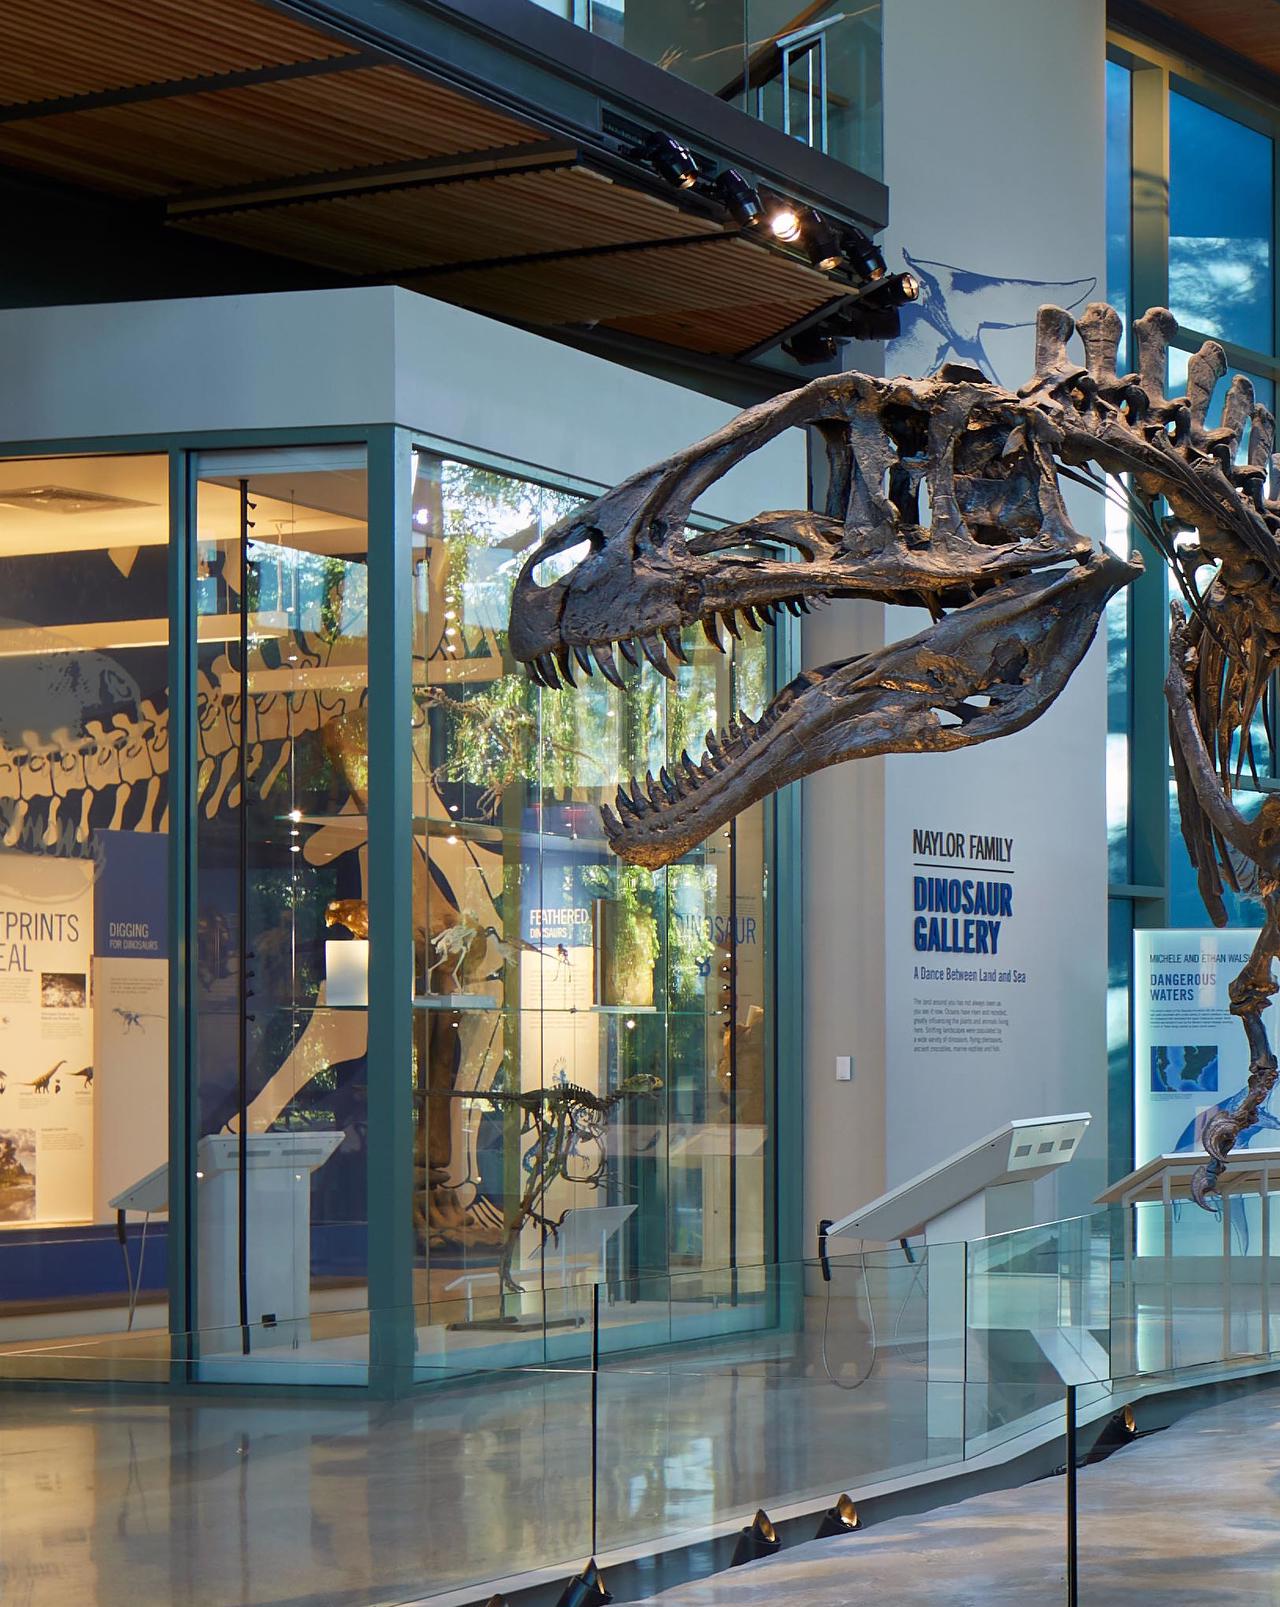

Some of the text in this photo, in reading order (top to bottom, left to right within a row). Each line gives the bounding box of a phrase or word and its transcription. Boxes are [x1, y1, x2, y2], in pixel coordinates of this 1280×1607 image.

[913, 829, 1013, 862] NAYLOR FAMILY
[914, 876, 1013, 917] DINOSAUR
[530, 908, 589, 925] FEATHERED
[109, 922, 149, 938] DIGGING
[914, 916, 1001, 955] GALLERY
[109, 939, 159, 951] FOR DINOSAURS
[1150, 954, 1251, 964] MICHELE AND ETHAN WALS
[914, 966, 1026, 984] A Dance Between Land and Sea
[1150, 973, 1216, 986] DANGEROUS
[1150, 988, 1194, 1001] WATERS
